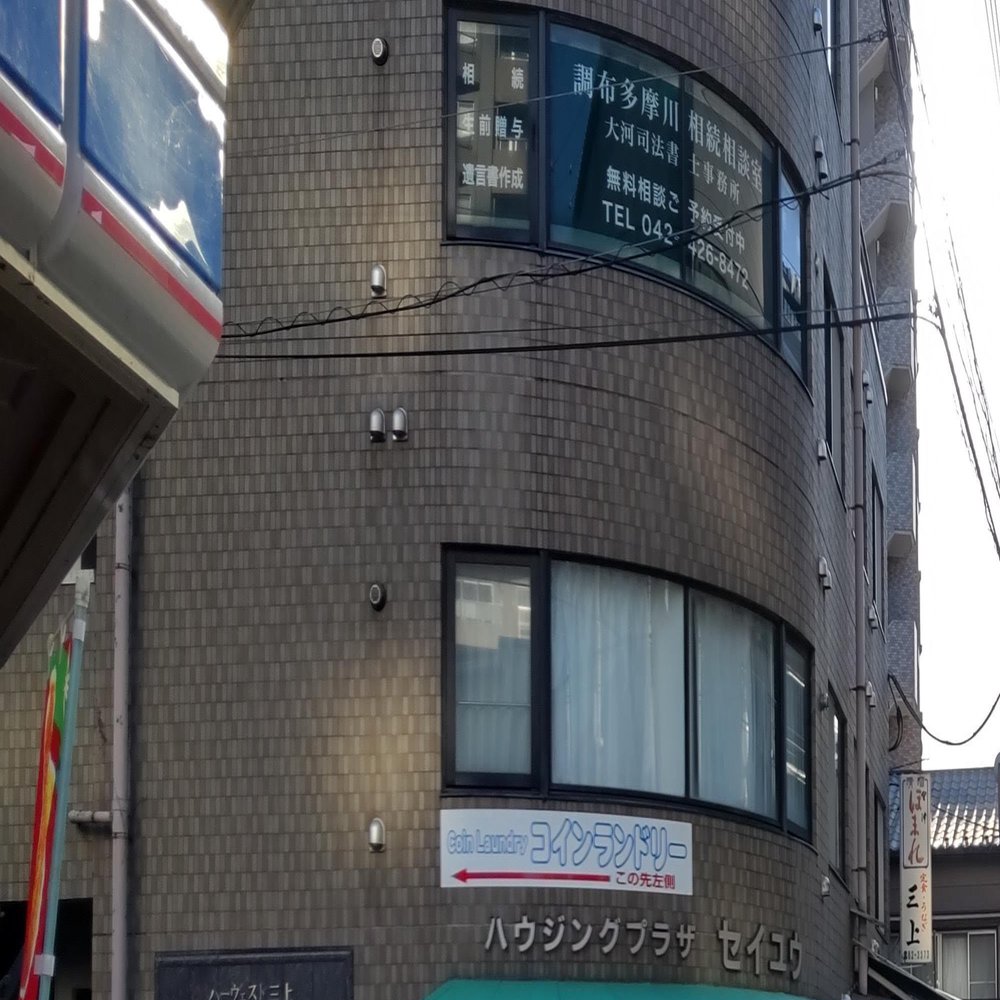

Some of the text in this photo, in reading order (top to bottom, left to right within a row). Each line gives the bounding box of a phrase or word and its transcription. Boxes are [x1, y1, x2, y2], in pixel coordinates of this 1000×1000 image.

[461, 113, 524, 140] 生前贈与
[462, 162, 524, 190] 遺言書作成
[602, 200, 636, 232] TEL
[447, 827, 529, 856] Coin Laundry
[530, 817, 688, 871] コインランドリー
[616, 871, 676, 890] この先左側
[906, 884, 921, 945] 三上
[484, 914, 802, 981] ハウジングプラザ セイユウ
